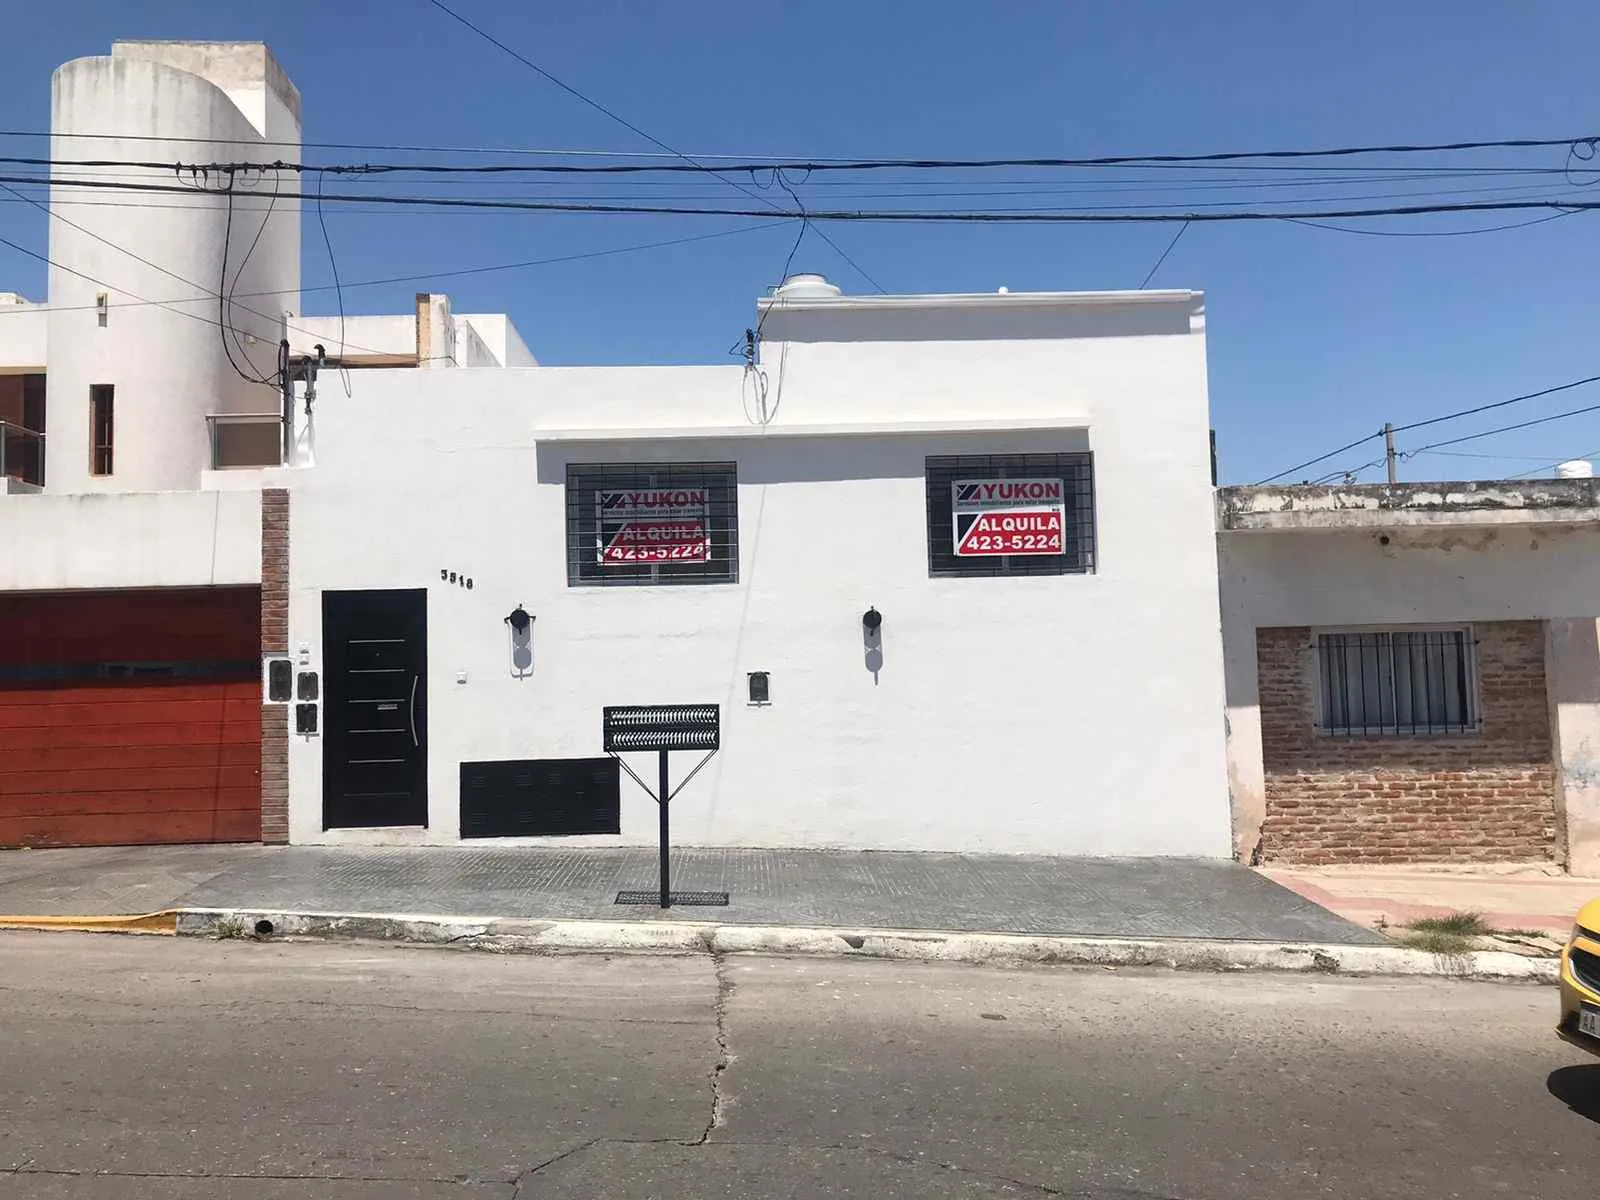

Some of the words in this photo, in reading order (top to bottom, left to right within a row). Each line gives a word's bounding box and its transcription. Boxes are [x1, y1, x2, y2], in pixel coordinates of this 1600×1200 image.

[983, 482, 1060, 499] YUKON
[628, 491, 705, 509] YUKON
[978, 516, 1060, 532] ALQUILA
[622, 525, 704, 541] ALQUILA
[966, 534, 1060, 550] 423-5224
